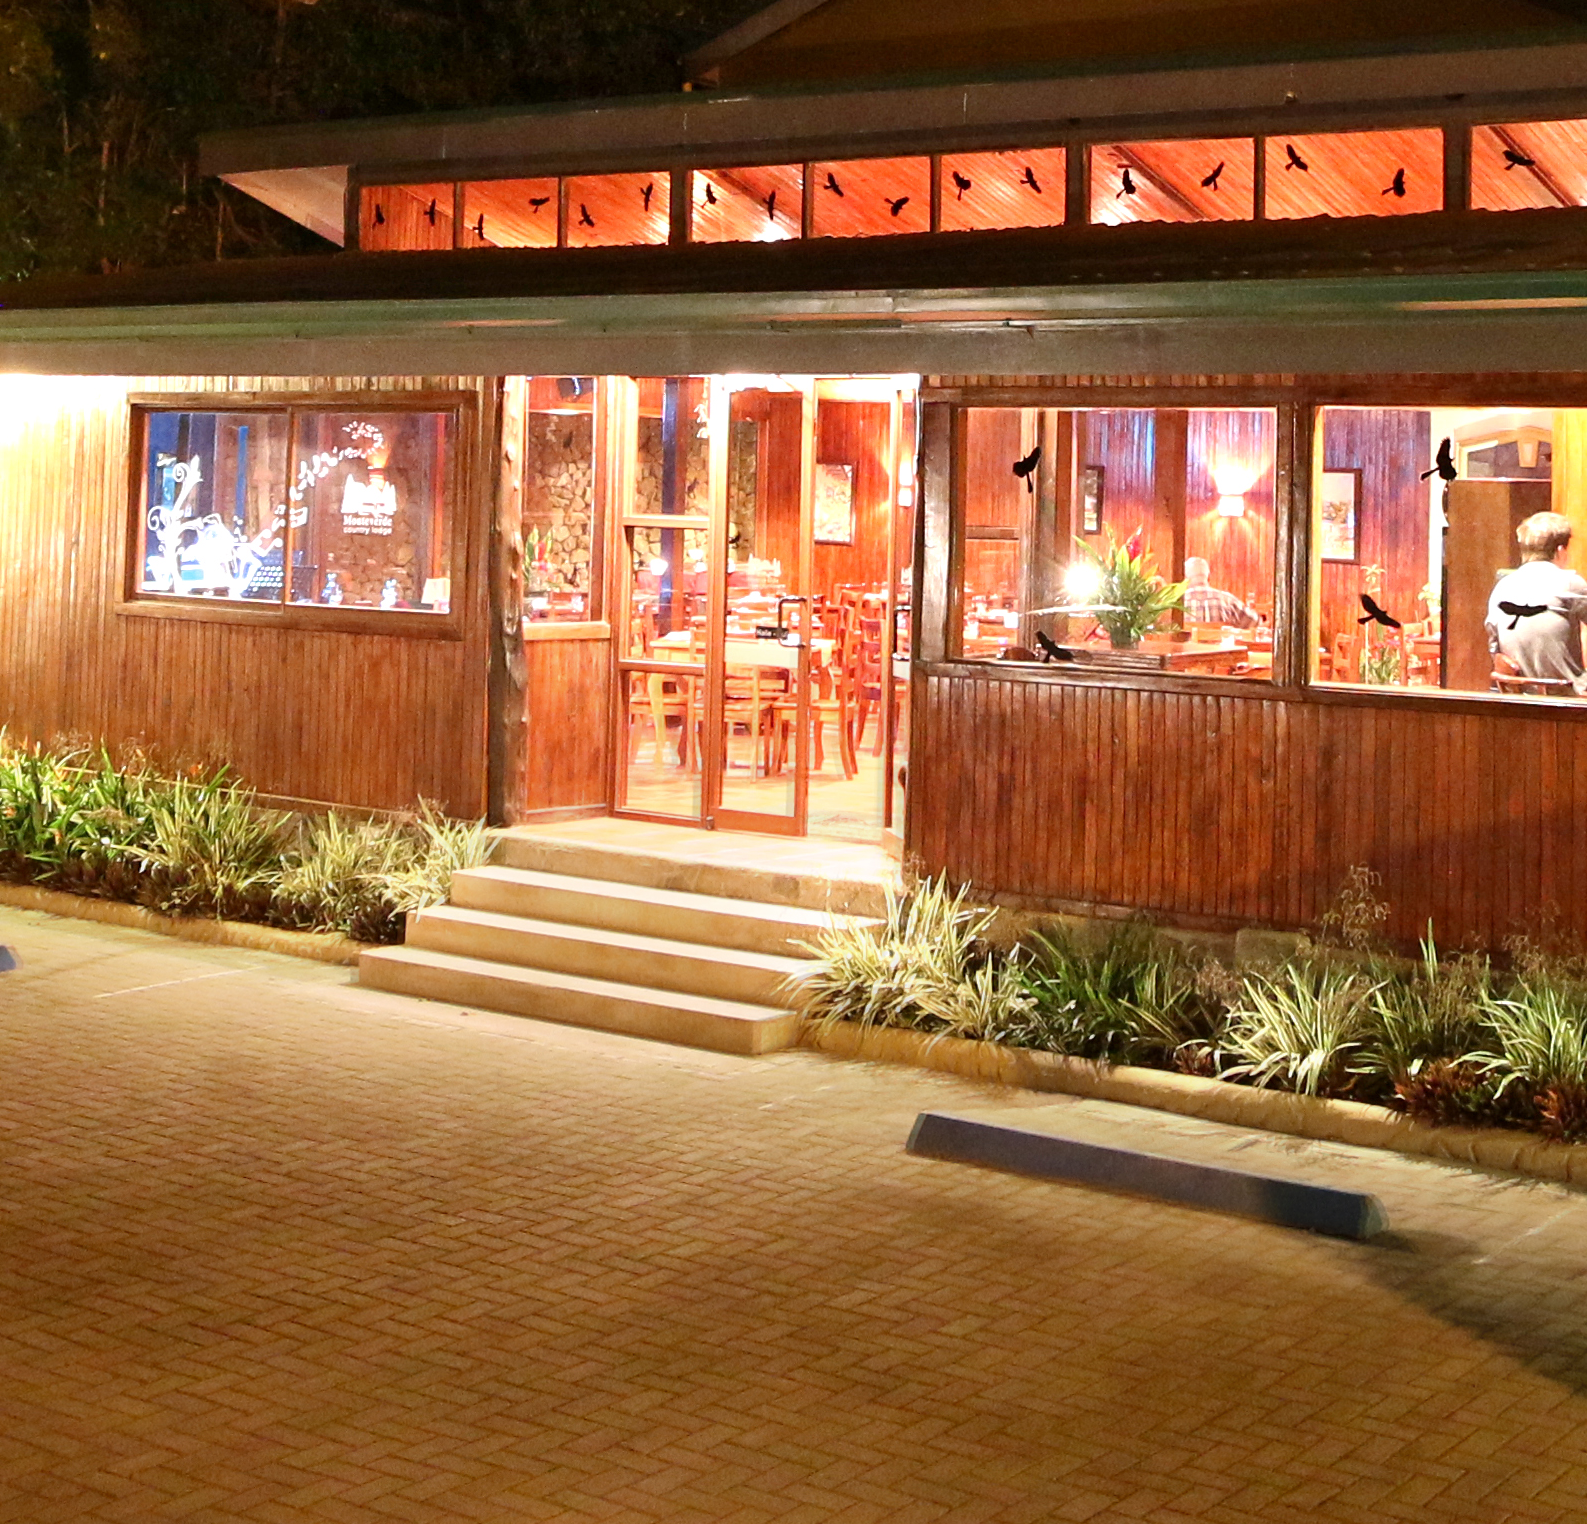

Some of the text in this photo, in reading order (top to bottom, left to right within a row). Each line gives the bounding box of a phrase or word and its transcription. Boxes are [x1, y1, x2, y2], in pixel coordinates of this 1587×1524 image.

[343, 514, 393, 527] Monteverde
[343, 526, 393, 536] country lodge
